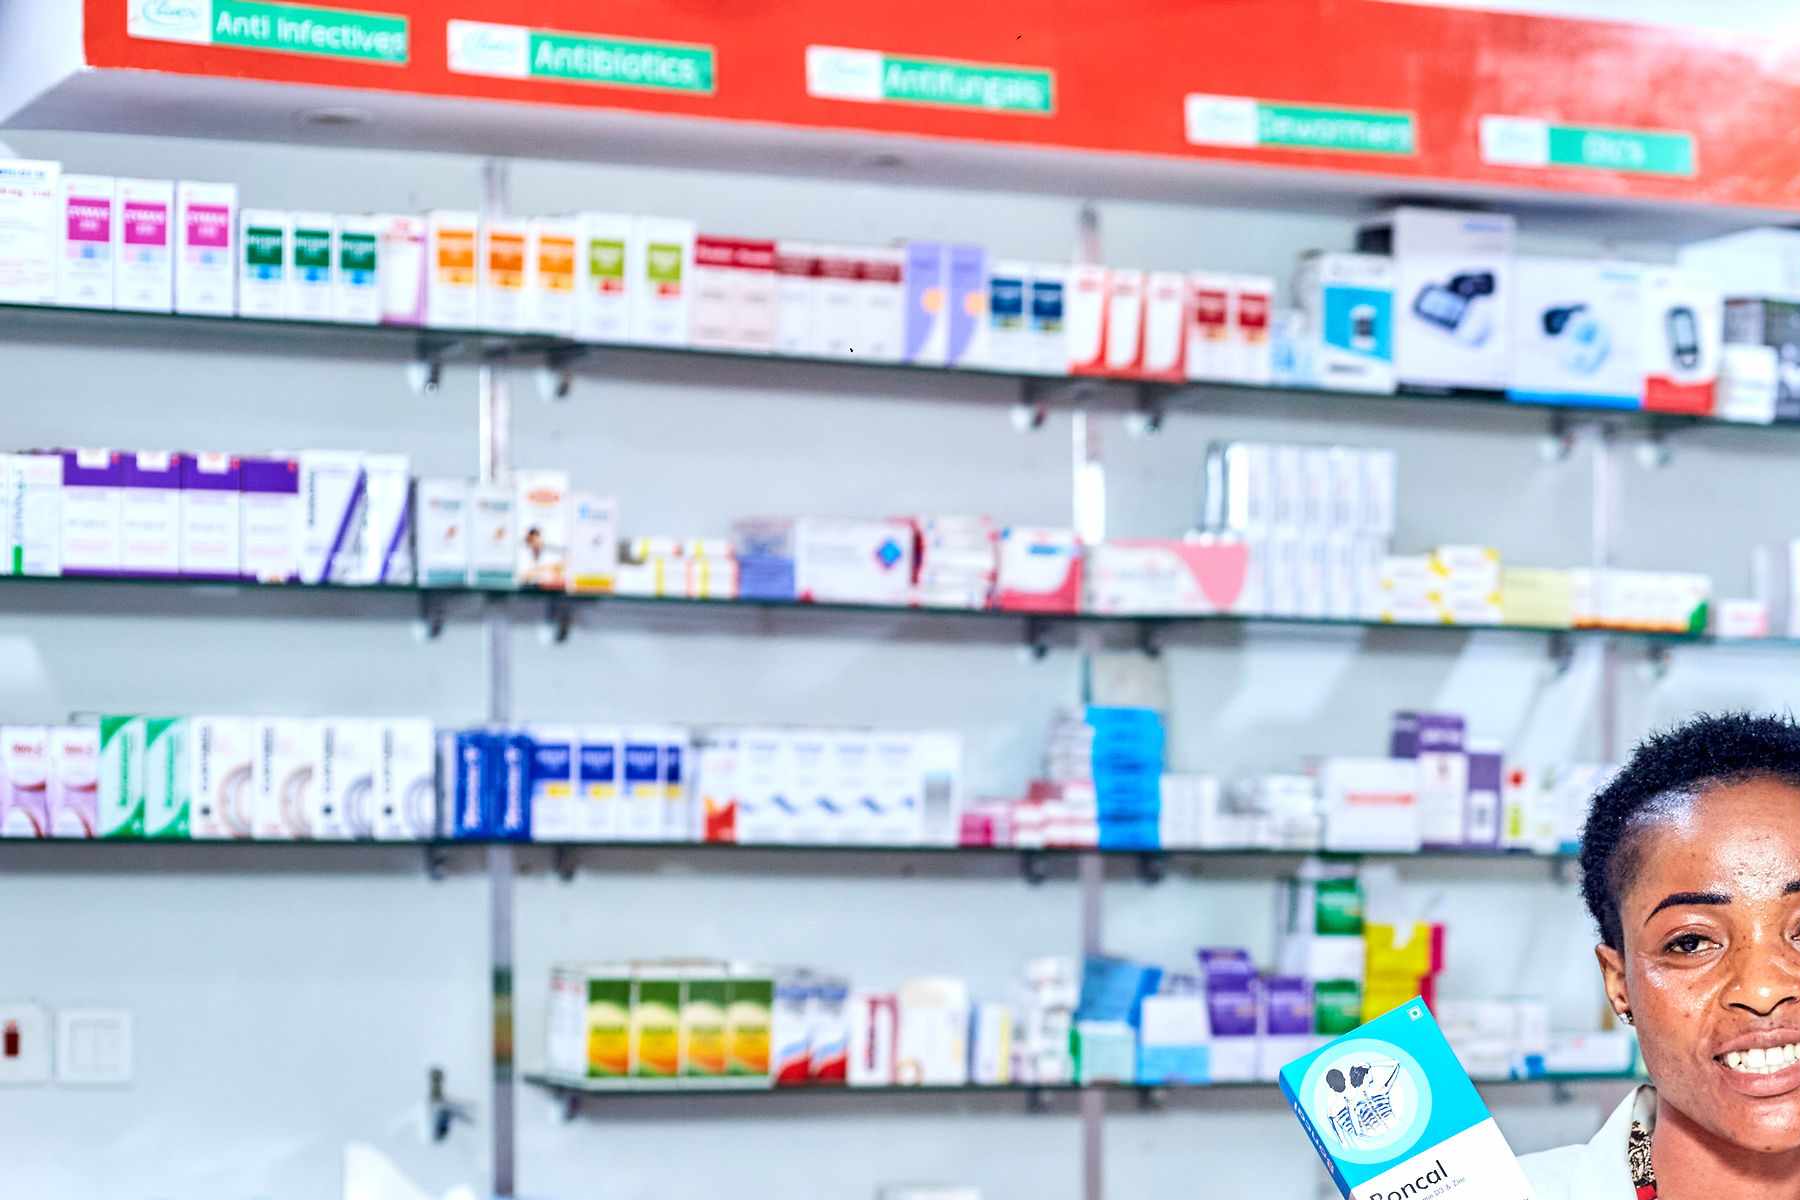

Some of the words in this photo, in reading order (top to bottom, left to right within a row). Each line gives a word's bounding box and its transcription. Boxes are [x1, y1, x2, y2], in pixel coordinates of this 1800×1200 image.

[216, 11, 270, 40] Anti
[278, 18, 407, 55] Infectives
[535, 40, 697, 85] Antibiotics
[886, 63, 1044, 110] Antifungals
